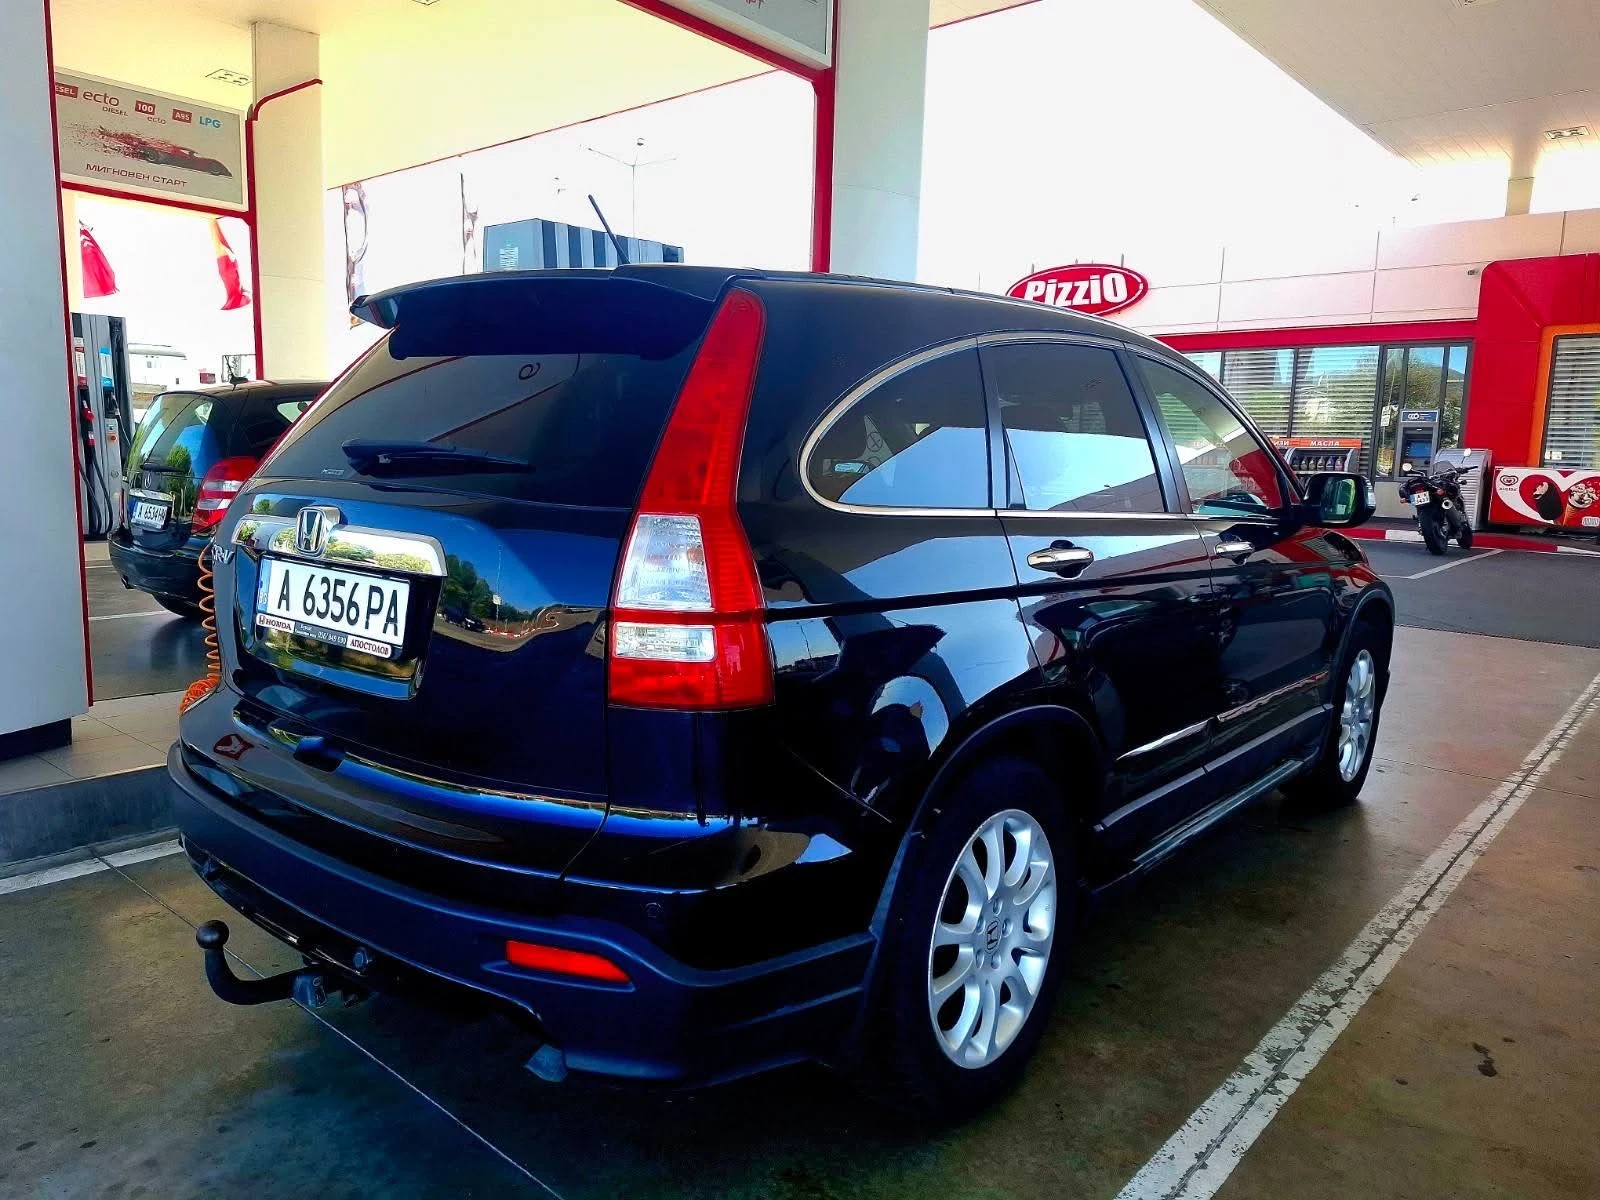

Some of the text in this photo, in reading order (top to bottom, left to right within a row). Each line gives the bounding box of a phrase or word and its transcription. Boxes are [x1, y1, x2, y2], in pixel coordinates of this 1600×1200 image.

[82, 91, 120, 107] ecto
[102, 106, 129, 117] DIESEL
[137, 103, 154, 113] 100
[175, 111, 190, 121] A95
[199, 115, 222, 129] LPG
[86, 163, 188, 188] МИГНОВЕН СТАРТ
[277, 568, 399, 637] A 6356 PA
[265, 616, 292, 631] HONDA
[349, 638, 390, 656] АПОСТОЛОВ
